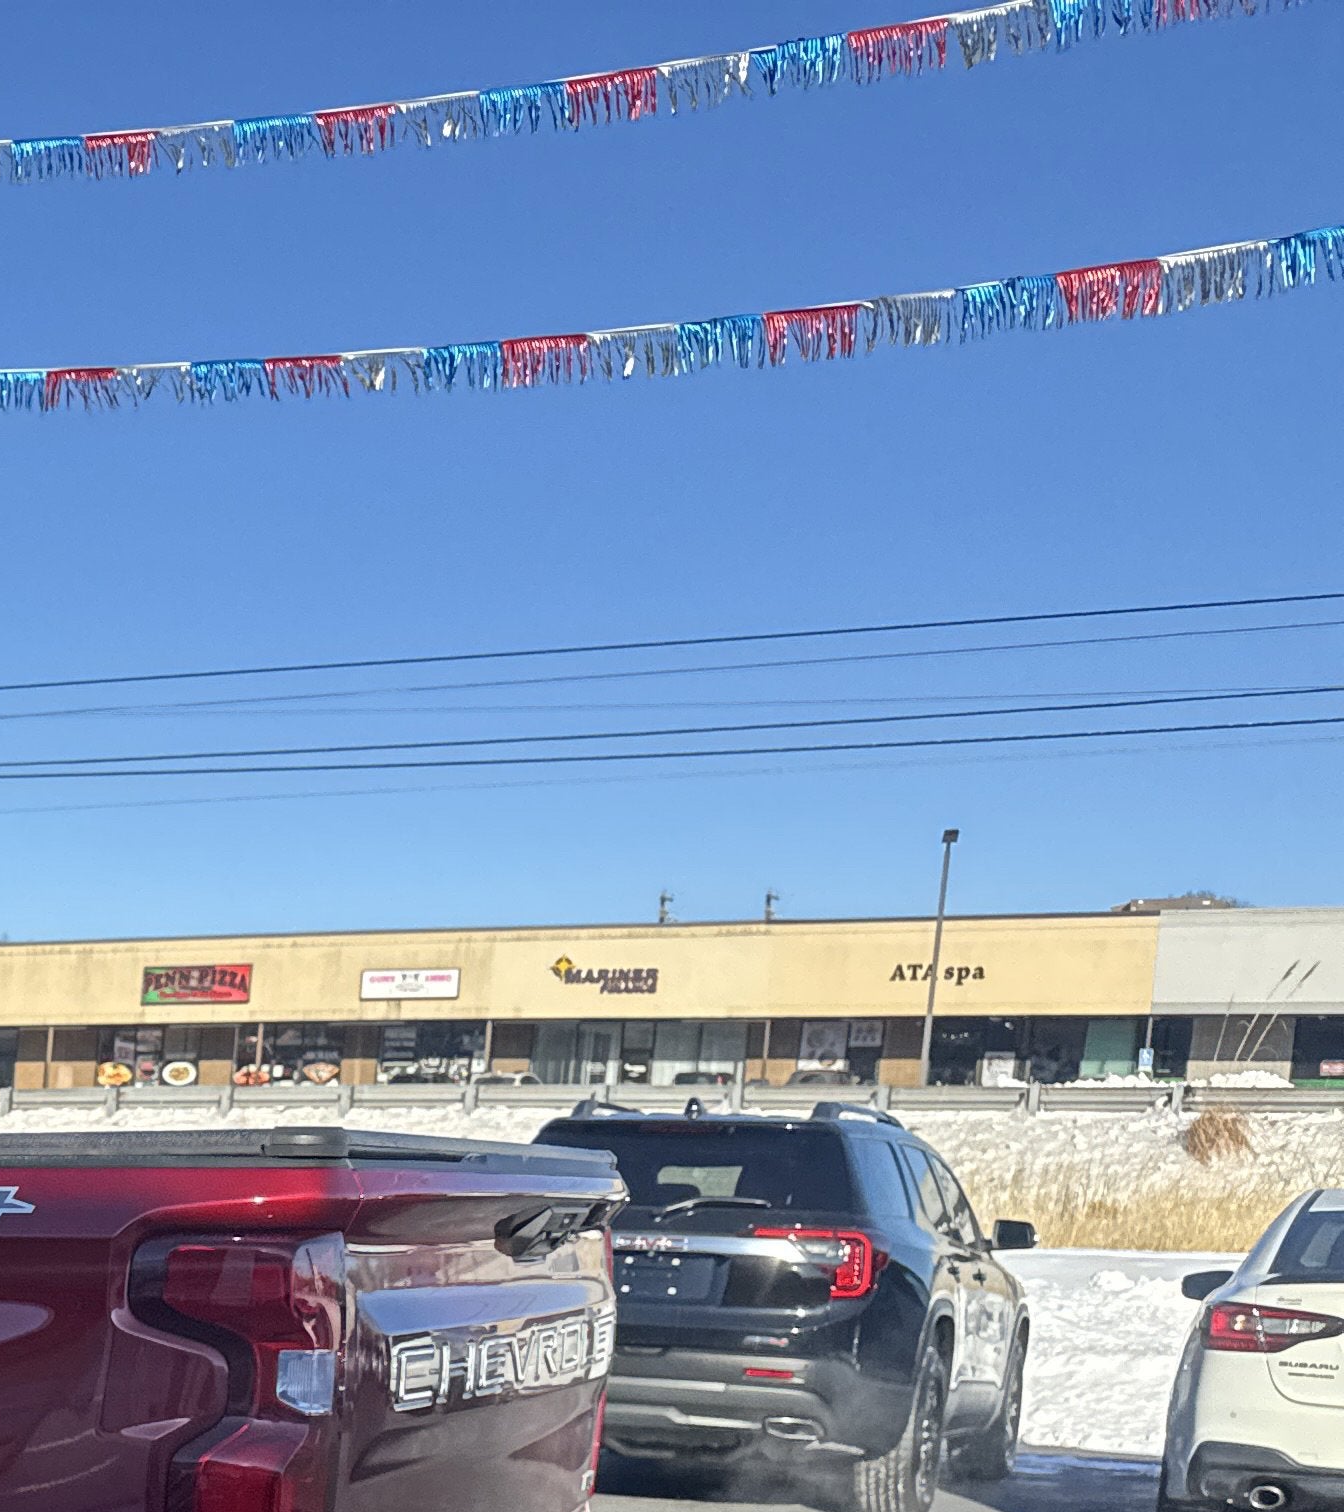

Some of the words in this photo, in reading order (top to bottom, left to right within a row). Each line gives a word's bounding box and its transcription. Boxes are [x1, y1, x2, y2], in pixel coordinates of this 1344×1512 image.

[143, 970, 189, 994] PENN
[198, 967, 248, 993] PIZZA
[564, 968, 659, 984] MARINER
[944, 966, 985, 986] spa
[1278, 1360, 1340, 1371] SUBARU
